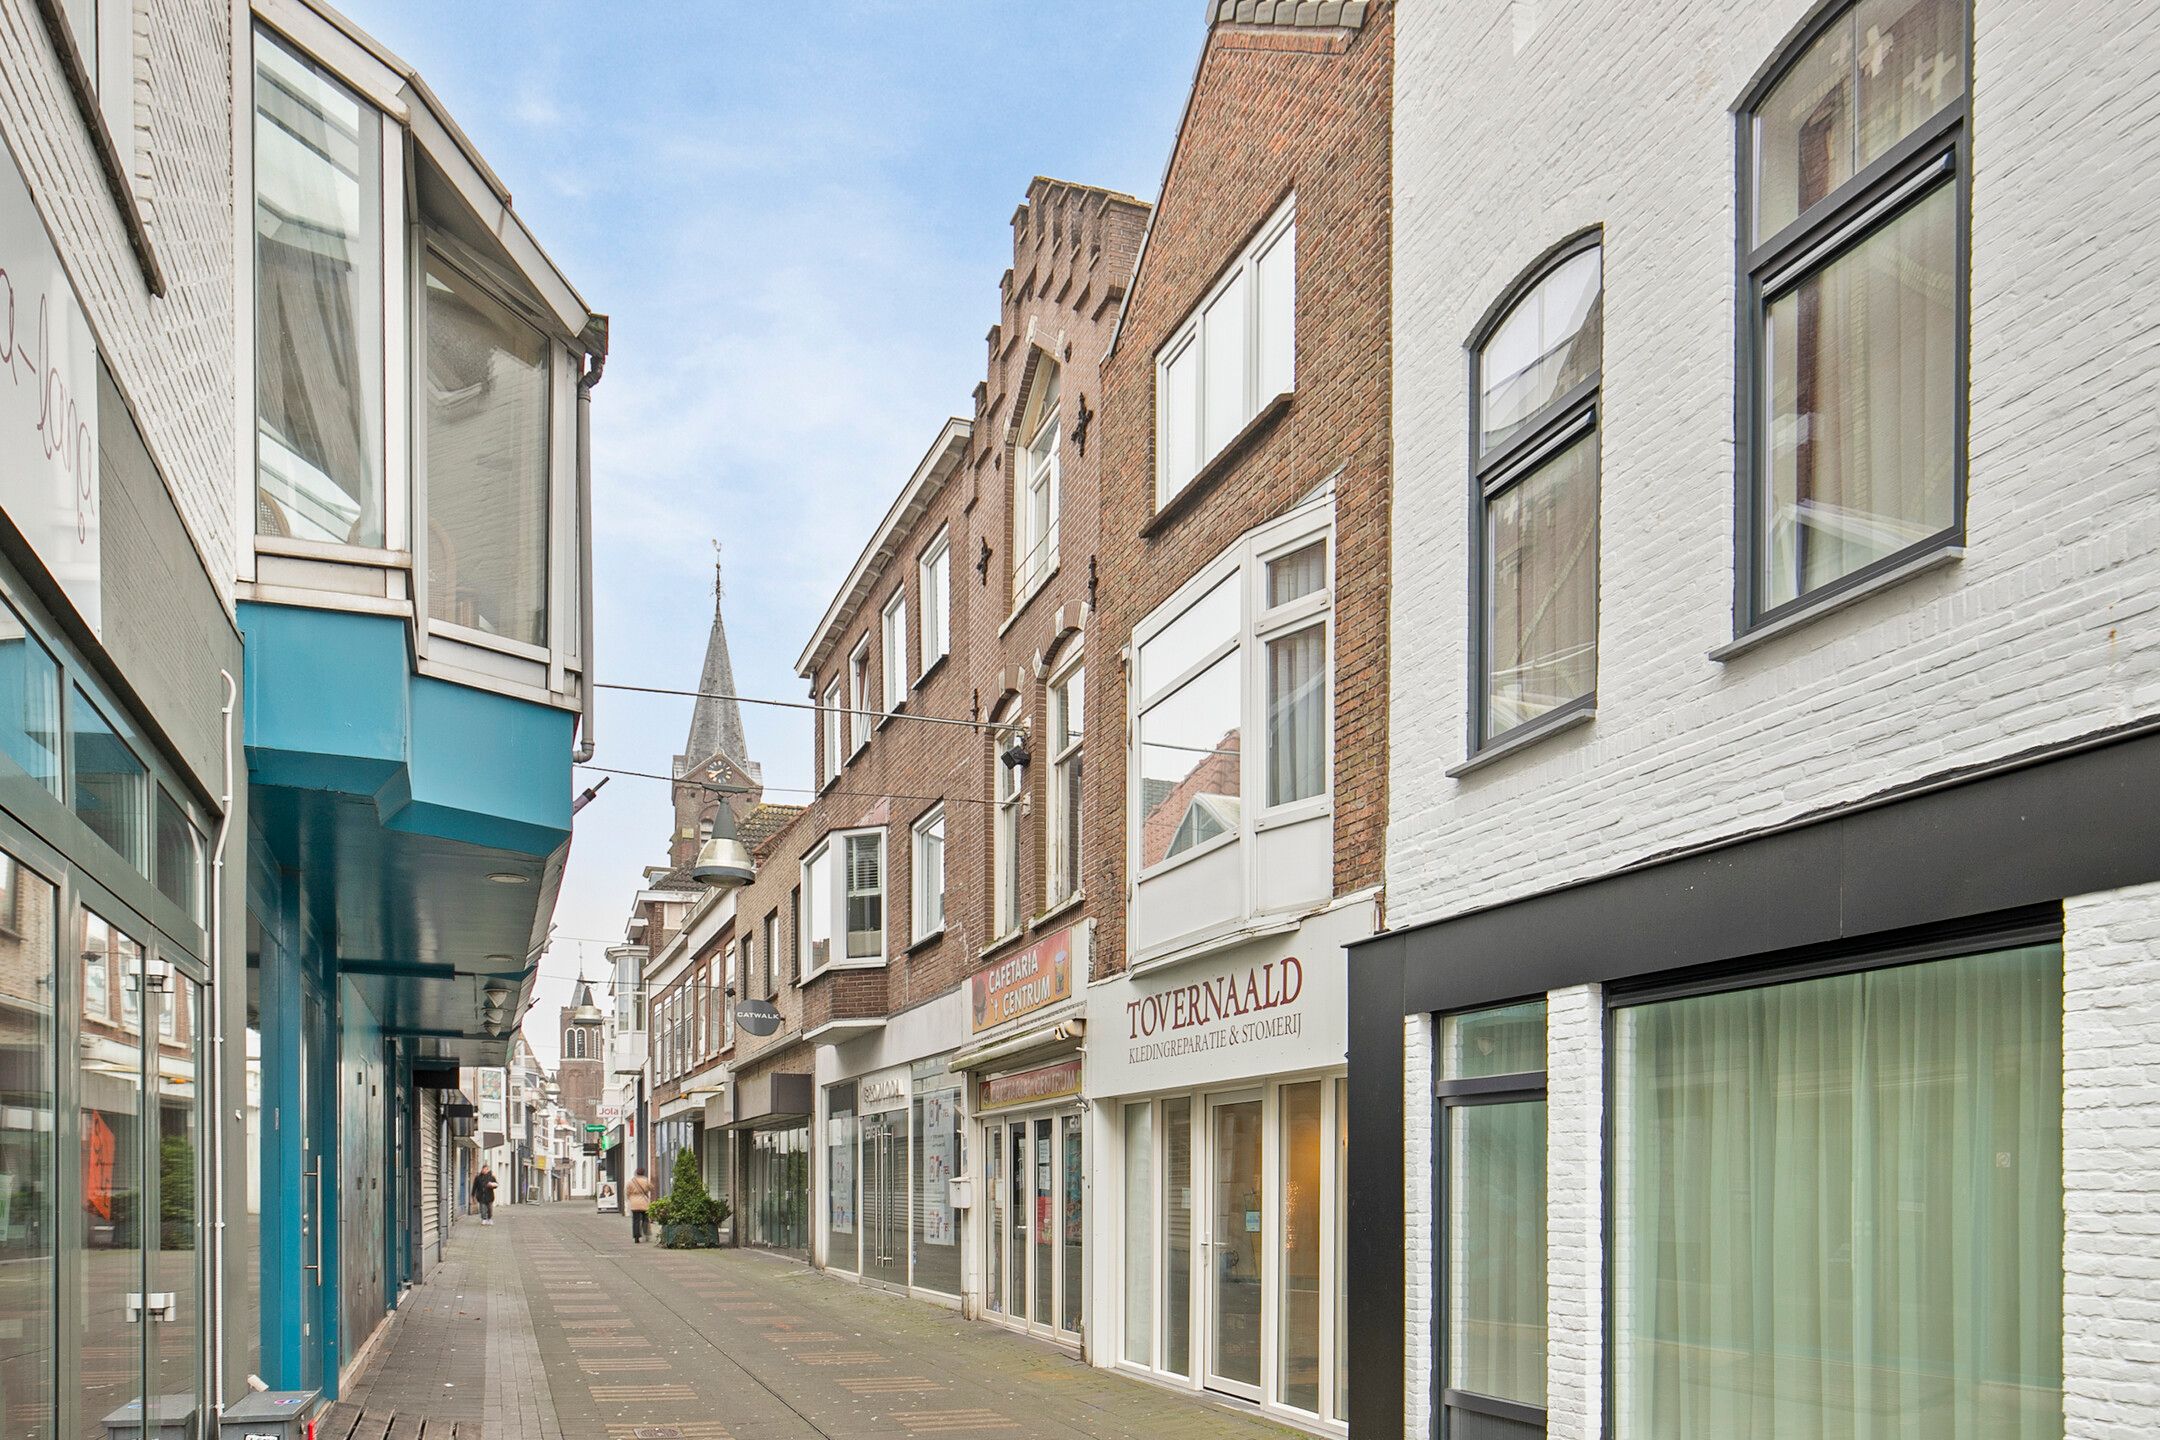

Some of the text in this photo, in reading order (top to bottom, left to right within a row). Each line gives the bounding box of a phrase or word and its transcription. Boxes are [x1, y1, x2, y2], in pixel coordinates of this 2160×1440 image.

[988, 949, 1039, 994] CAFETARIA
[737, 1011, 779, 1020] CATWALK
[1002, 975, 1051, 1017] CENTRUM
[1126, 956, 1304, 1040] TOVERNAALD
[1128, 1012, 1303, 1064] KLEDINGREPARATIE & STOMERIJ
